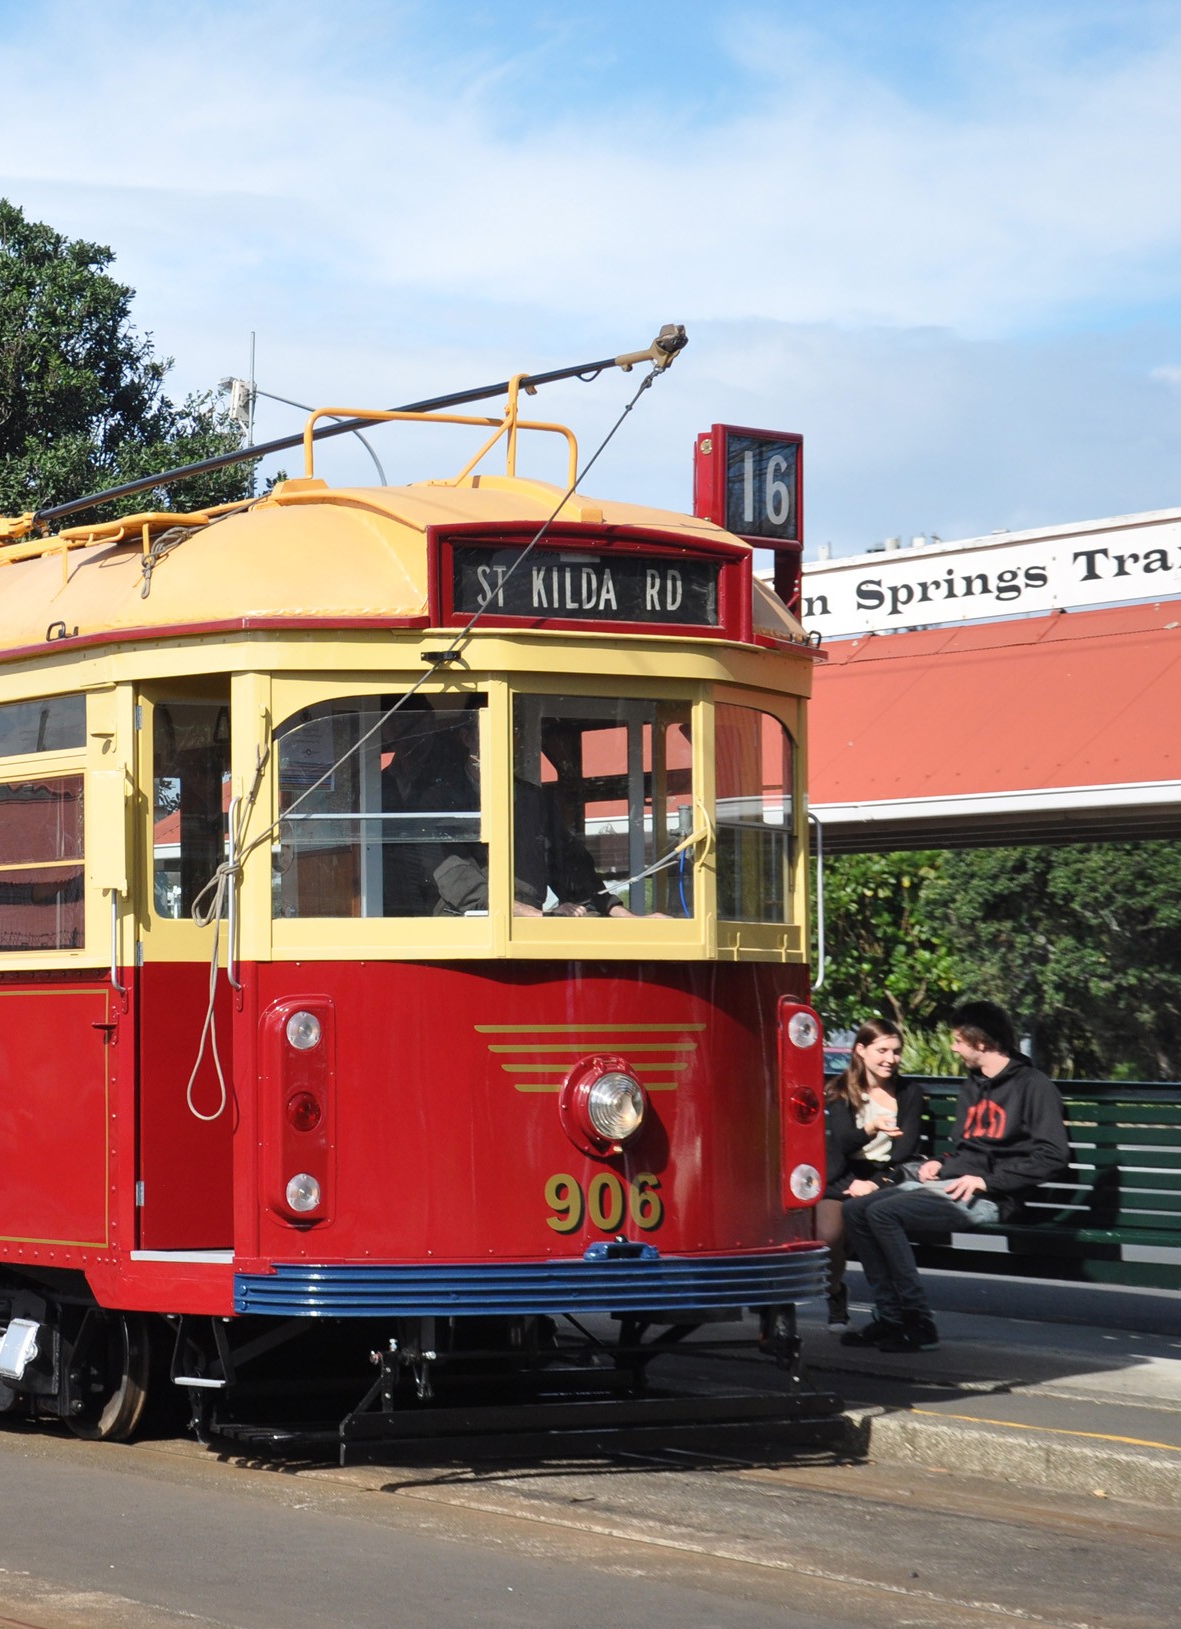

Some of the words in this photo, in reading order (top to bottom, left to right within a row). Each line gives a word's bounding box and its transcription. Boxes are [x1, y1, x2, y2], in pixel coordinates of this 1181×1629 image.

[744, 450, 790, 525] 16
[477, 564, 507, 607] ST
[532, 566, 618, 611] KILDA
[646, 569, 683, 611] RD
[855, 565, 1049, 616] Springs
[1072, 547, 1181, 582] Tra
[544, 1171, 664, 1234] 906
